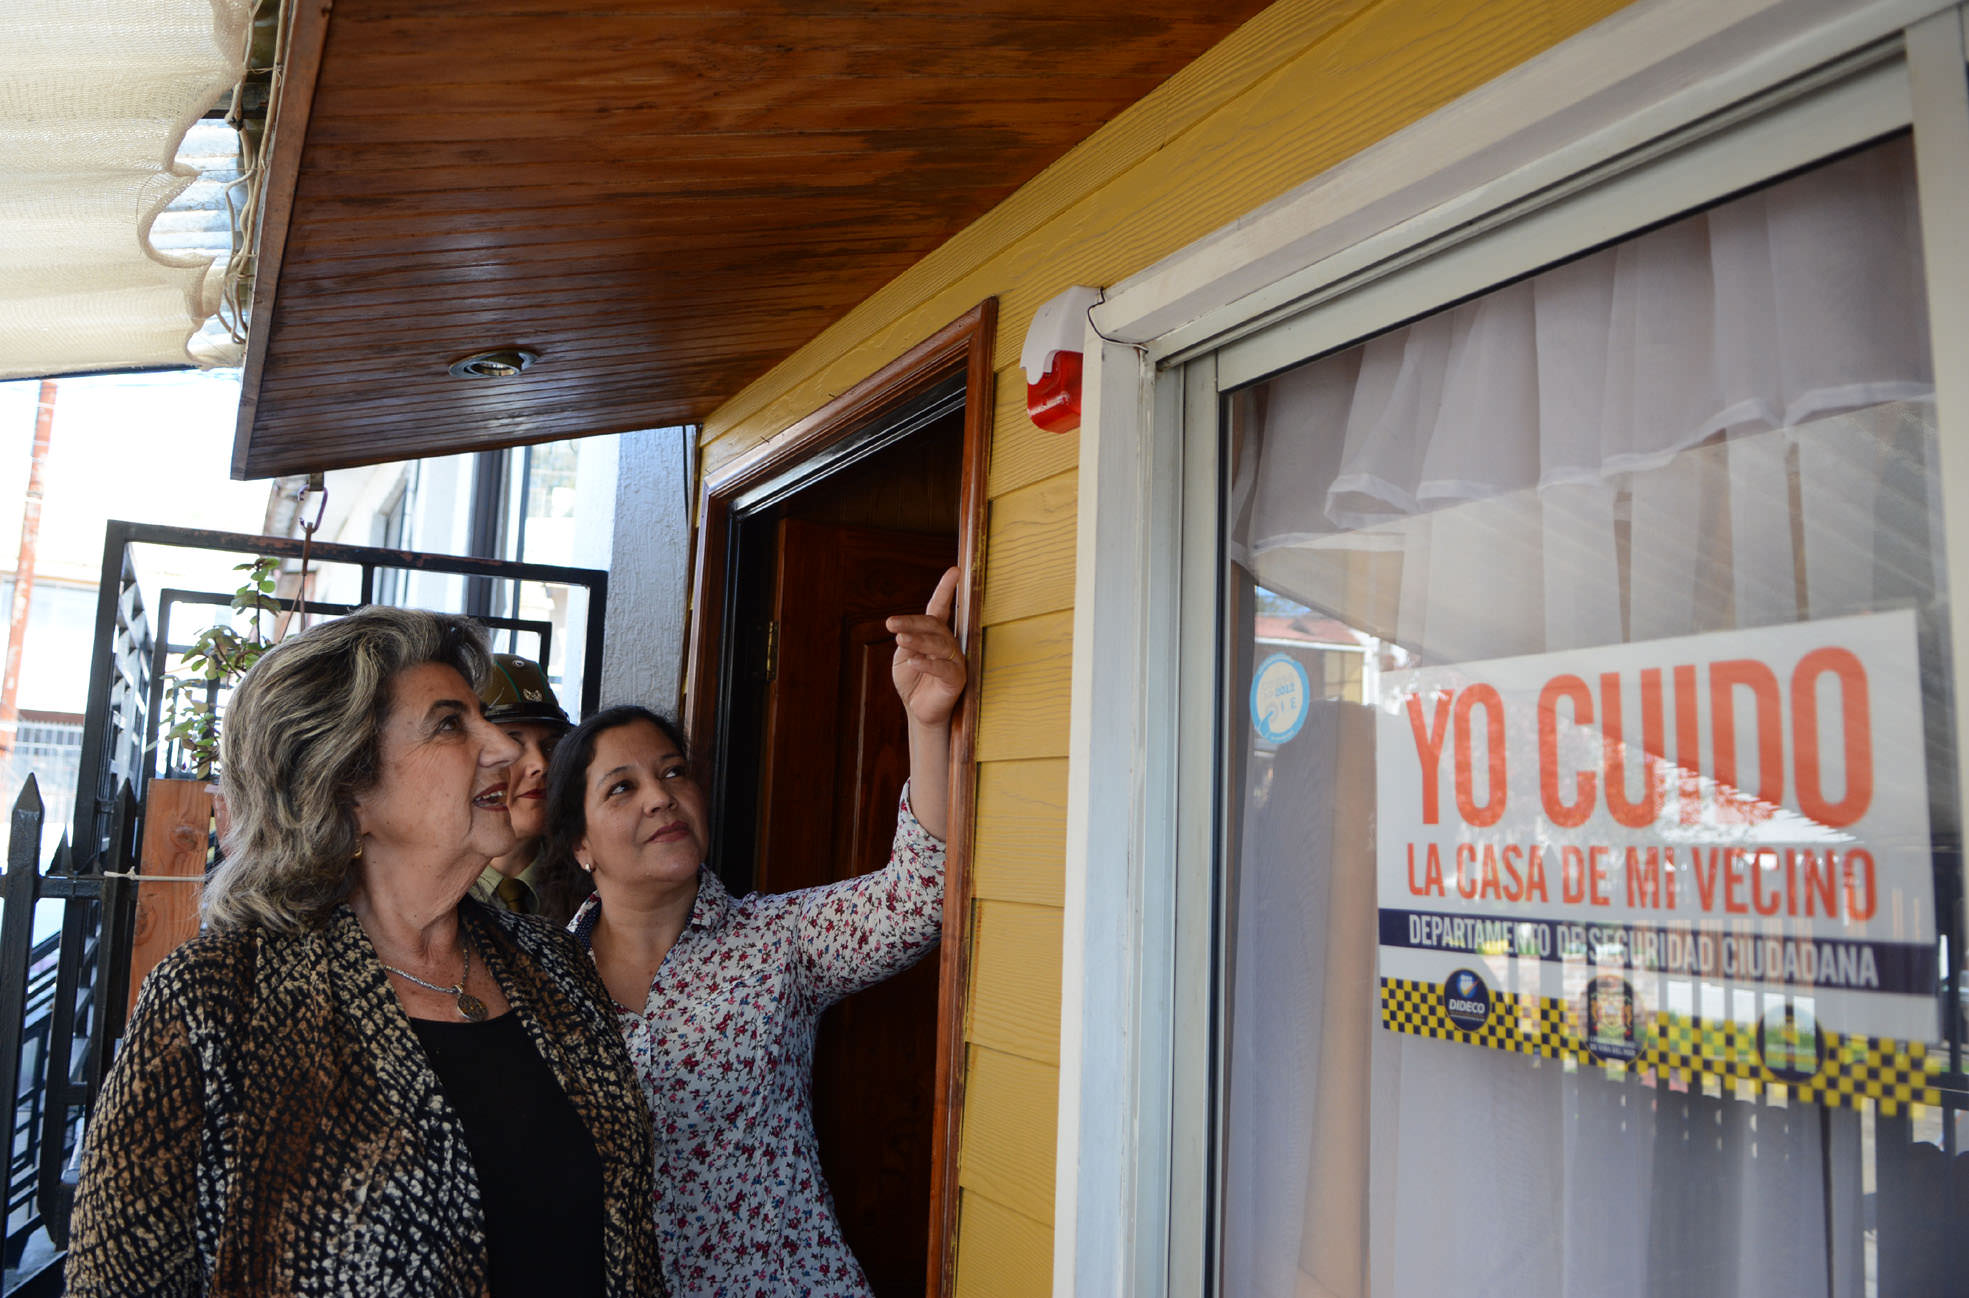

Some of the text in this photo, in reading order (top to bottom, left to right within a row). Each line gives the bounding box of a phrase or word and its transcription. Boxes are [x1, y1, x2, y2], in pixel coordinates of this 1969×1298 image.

[1406, 645, 1875, 829] YO CUIDO
[1407, 842, 1878, 922] LA CASA DE MI VECINO
[1408, 914, 1550, 958] DEPARTAMENTO
[1588, 926, 1714, 974] SEGURIDAD
[1721, 935, 1880, 989] CIUDADANA
[1448, 998, 1486, 1015] DIDECO
